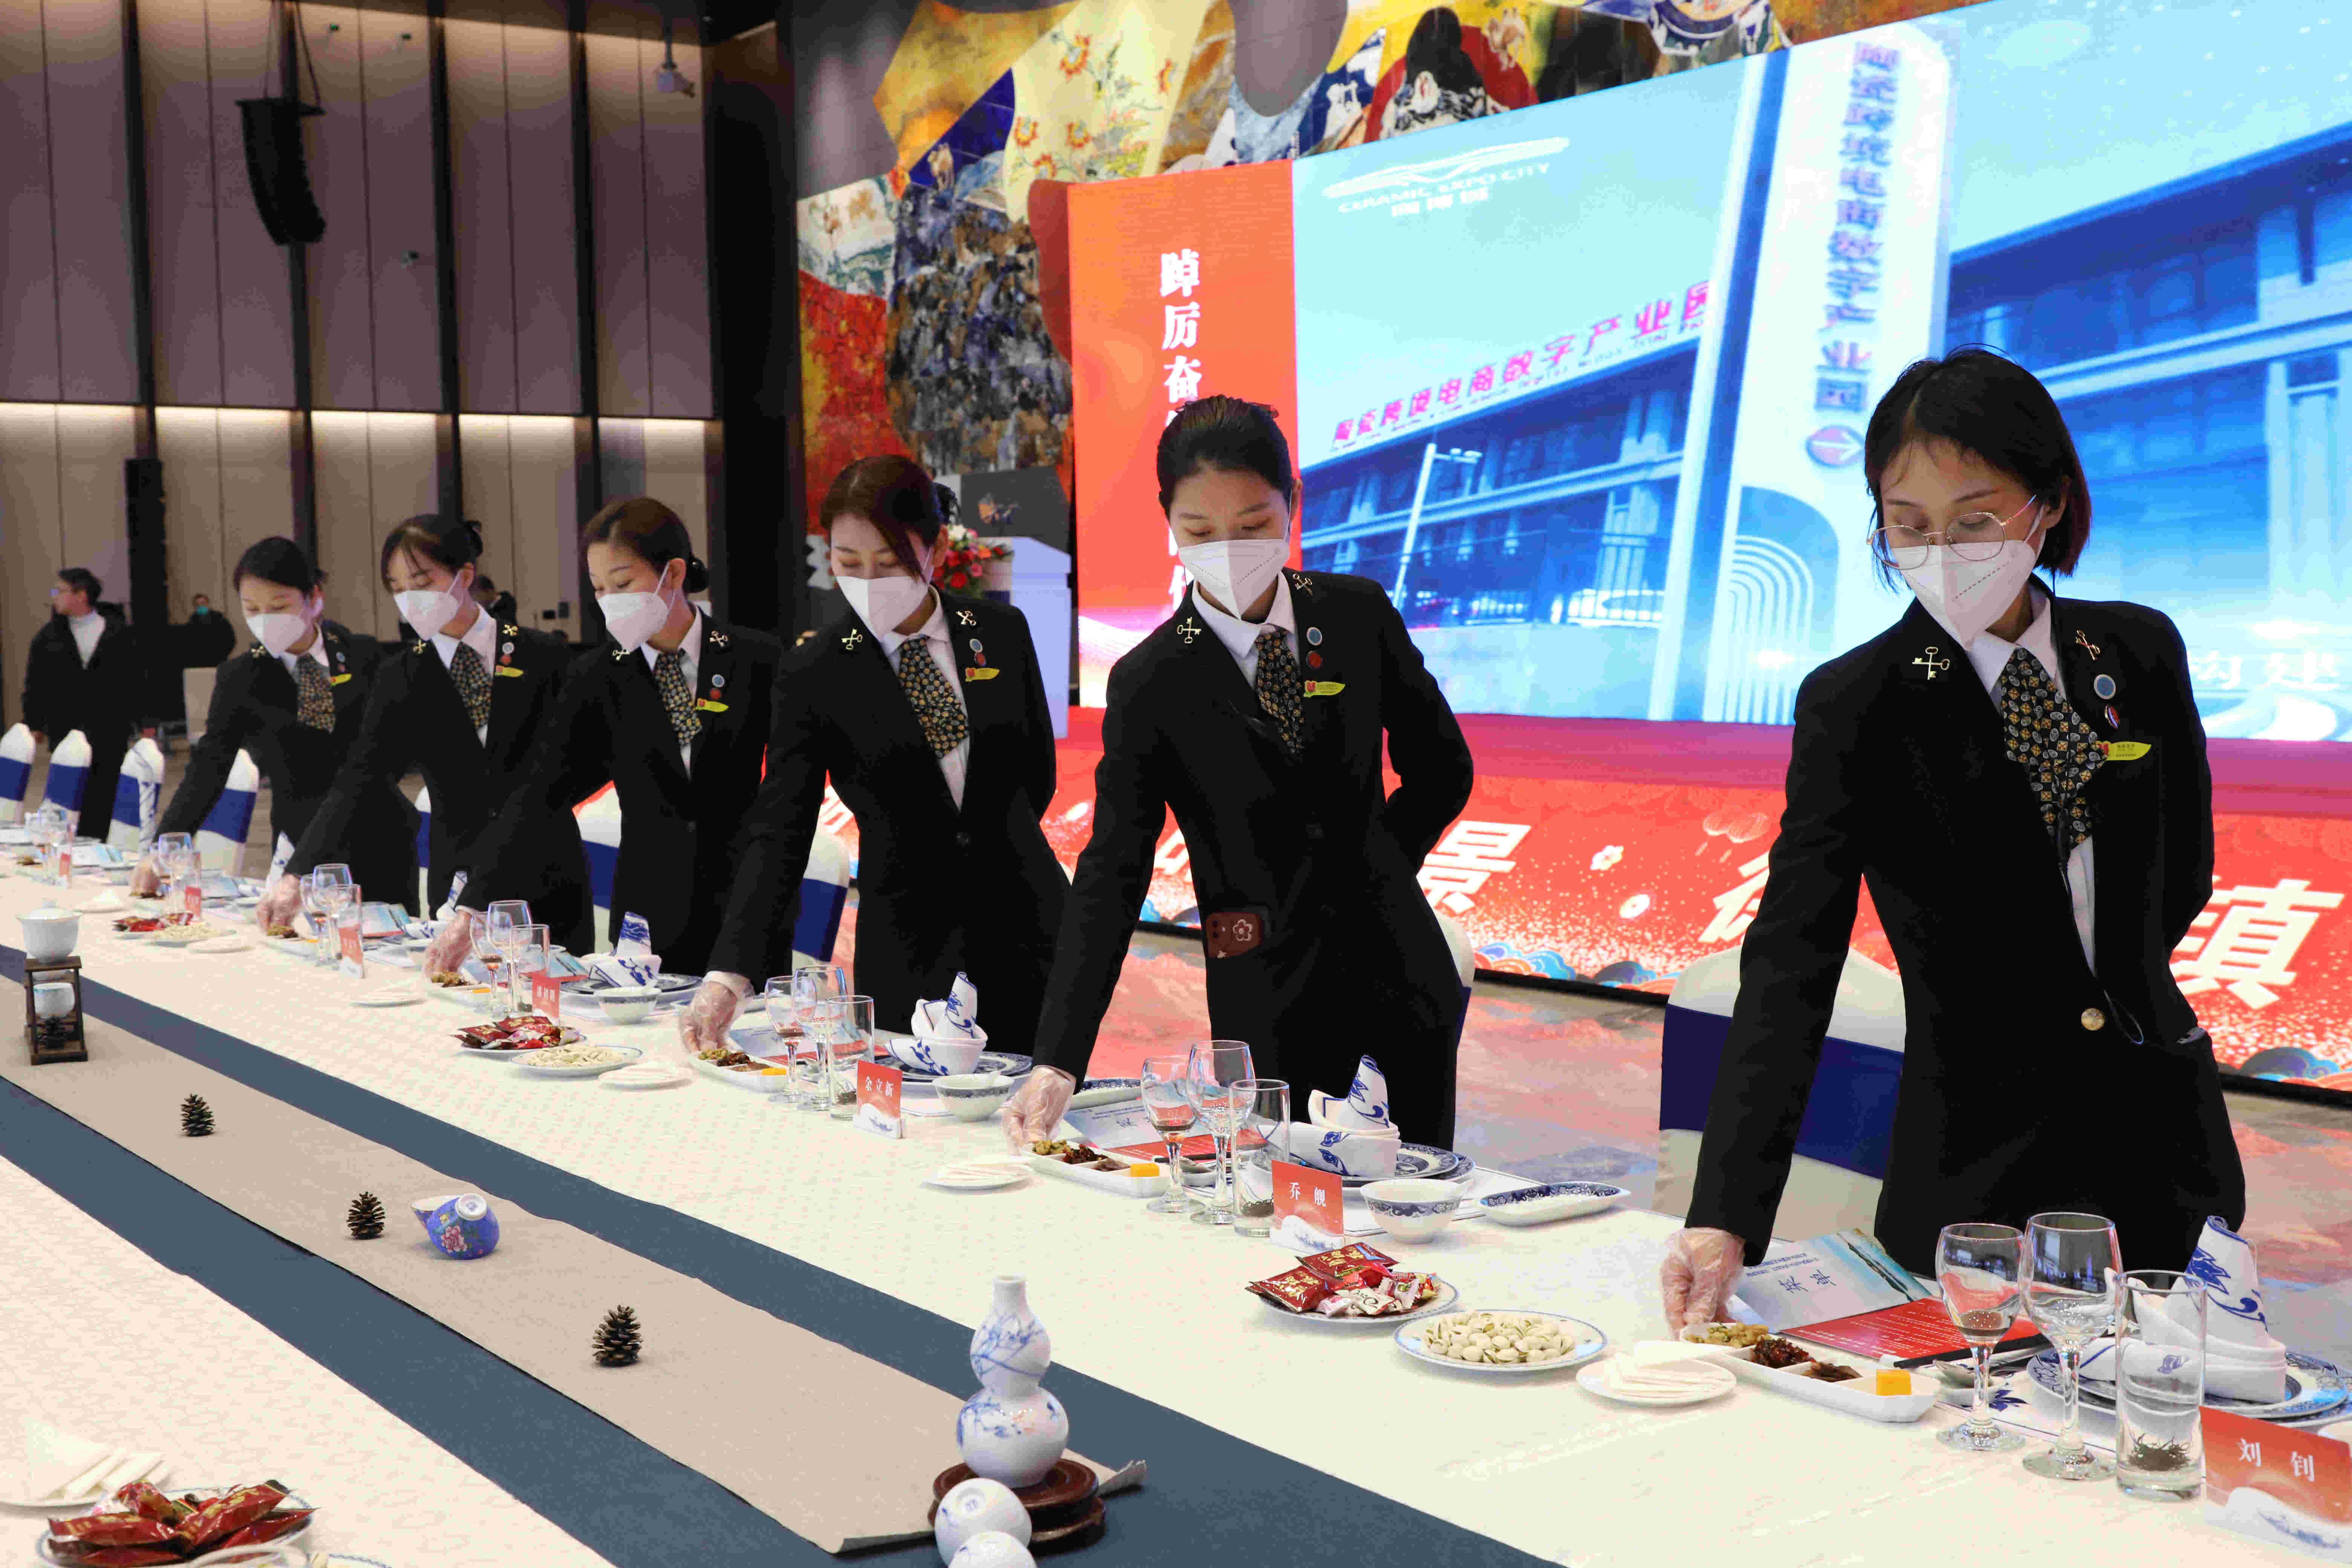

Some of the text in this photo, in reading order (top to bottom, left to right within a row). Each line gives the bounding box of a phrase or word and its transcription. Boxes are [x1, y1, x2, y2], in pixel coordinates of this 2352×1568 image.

[1501, 162, 1551, 181] CITY
[1160, 248, 1202, 427] 踔厉奋
